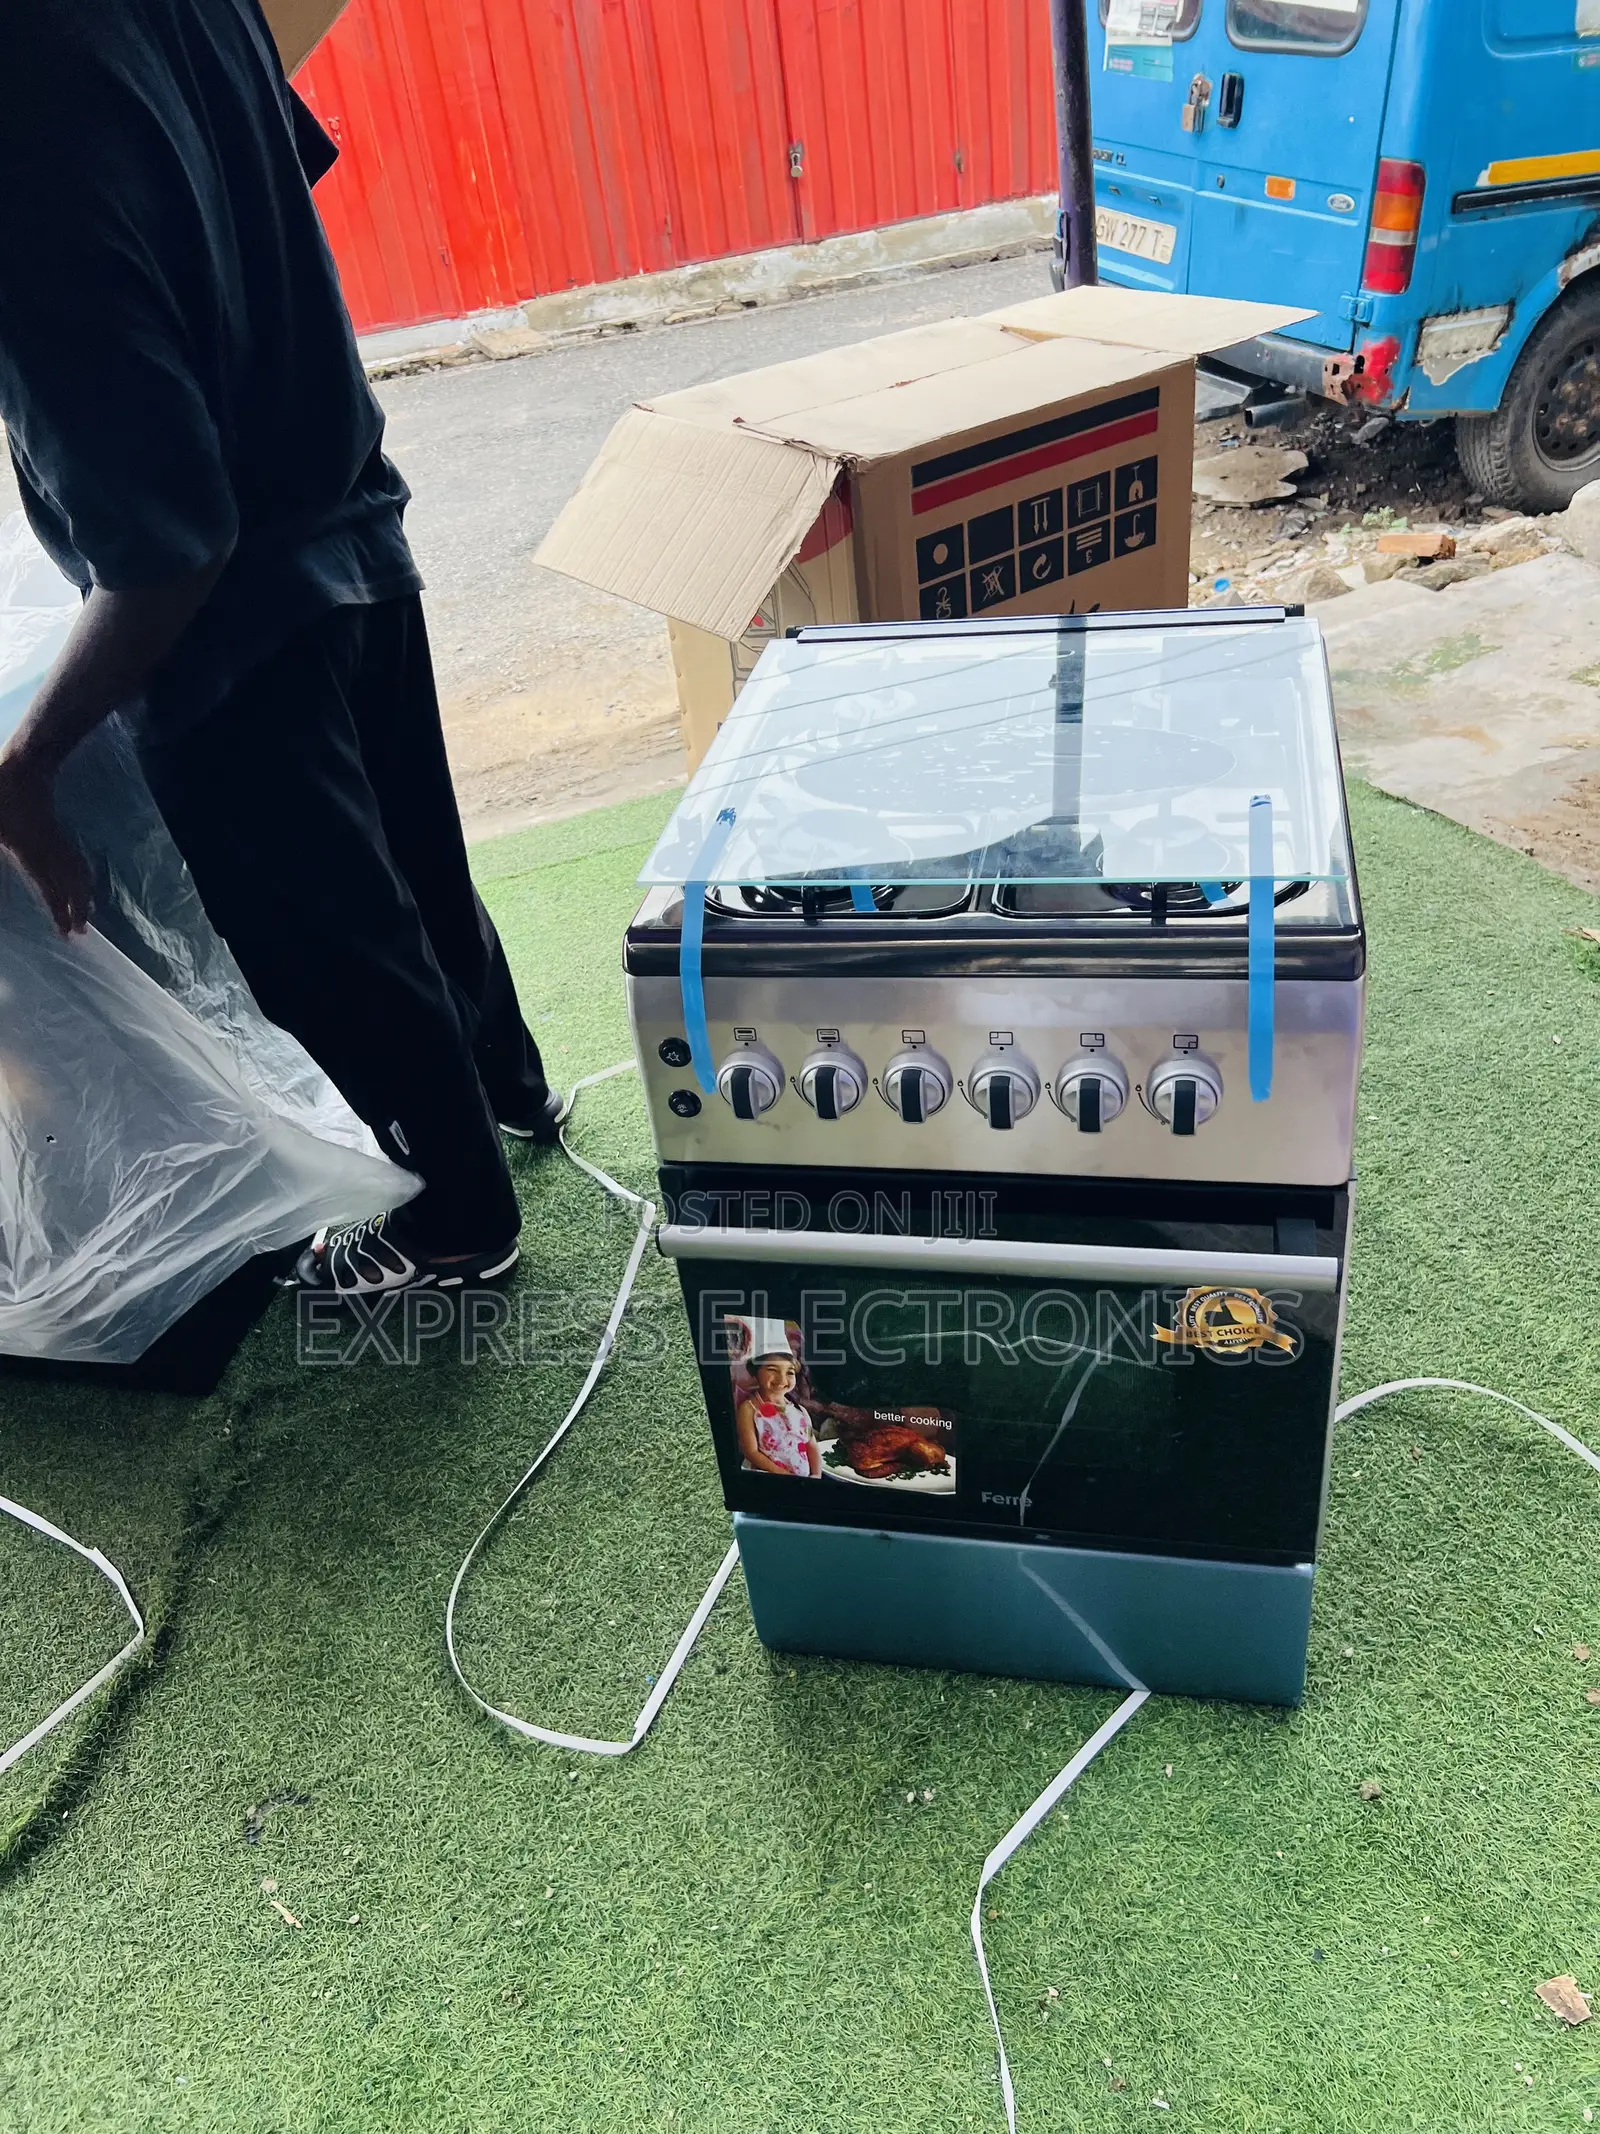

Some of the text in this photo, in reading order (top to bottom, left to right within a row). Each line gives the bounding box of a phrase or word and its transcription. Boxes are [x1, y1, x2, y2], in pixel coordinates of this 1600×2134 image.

[1096, 214, 1119, 243] GW
[1119, 221, 1147, 252] 277
[1186, 1327, 1261, 1338] BEST CHOICE
[874, 1410, 952, 1430] better cooking
